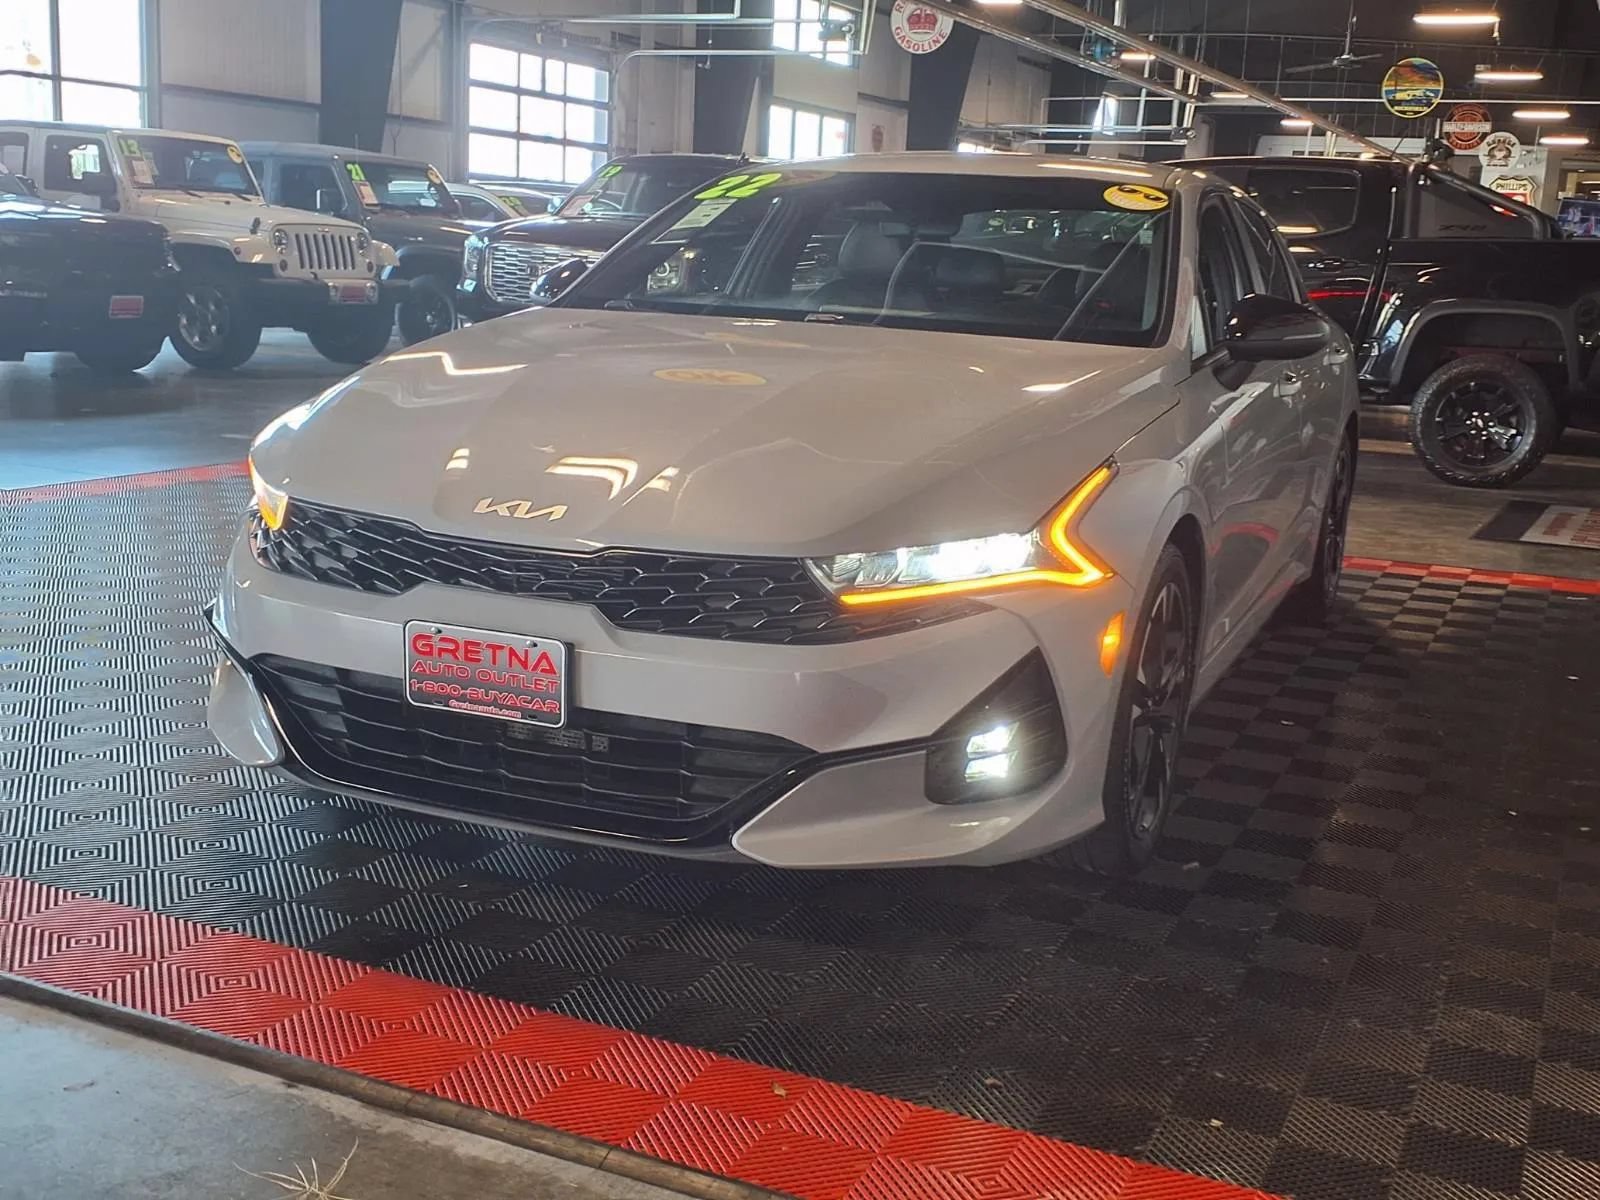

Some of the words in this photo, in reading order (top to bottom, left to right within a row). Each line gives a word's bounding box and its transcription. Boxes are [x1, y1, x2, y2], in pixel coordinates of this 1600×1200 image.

[895, 26, 948, 52] GASOLINE
[346, 163, 366, 181] 21
[694, 173, 782, 200] 22
[1495, 182, 1528, 191] PHILLIPS
[473, 497, 569, 522] KIA
[411, 632, 560, 677] GRETNA
[411, 659, 471, 682] AUTO
[475, 668, 561, 694] OUTLET
[410, 679, 560, 713] 1-800-BUYACAR
